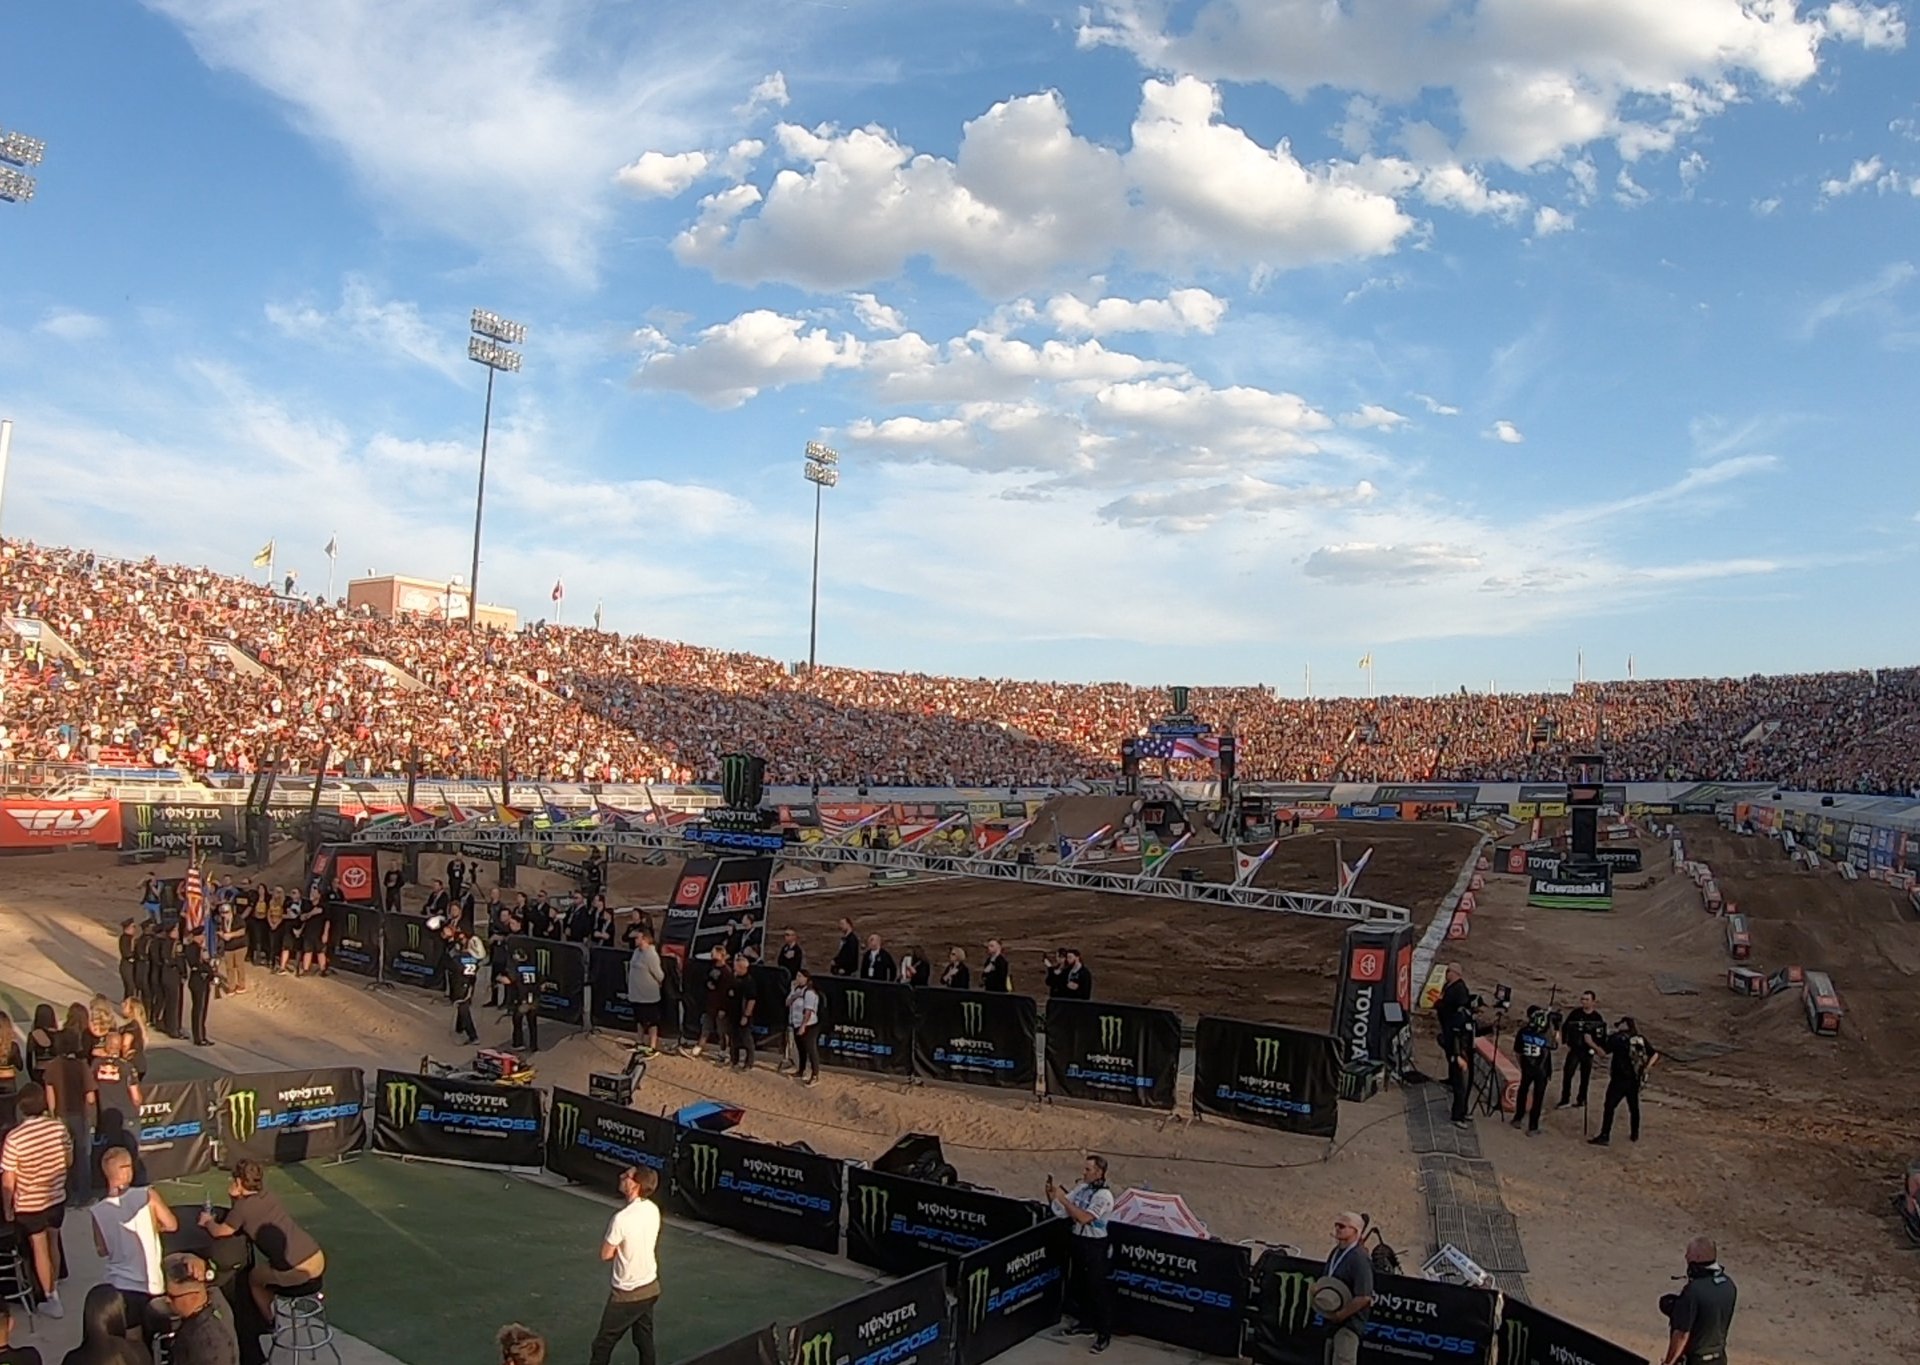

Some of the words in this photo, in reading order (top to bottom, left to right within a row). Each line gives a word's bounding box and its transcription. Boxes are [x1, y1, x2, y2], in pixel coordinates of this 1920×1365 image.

[30, 809, 110, 829] FLY
[153, 804, 222, 821] MONSTER
[706, 809, 758, 822] MONSTER
[685, 830, 782, 847] SUPERCROSS
[1536, 880, 1605, 894] Kawasaki
[463, 964, 477, 975] 22
[1351, 986, 1373, 1061] TOYOTA
[278, 1085, 334, 1102] MONSTER
[443, 1091, 509, 1108] MONSTER
[417, 1109, 537, 1131] SUPERCROSS
[597, 1117, 645, 1141] MONSTER
[743, 1158, 804, 1182] MONSTER
[718, 1175, 832, 1212] SUPERCROSS
[917, 1201, 987, 1227] MONSTER
[1006, 1246, 1047, 1274] MONSTER
[1121, 1244, 1198, 1273] MONSTER
[858, 1302, 917, 1339] MONSTER
